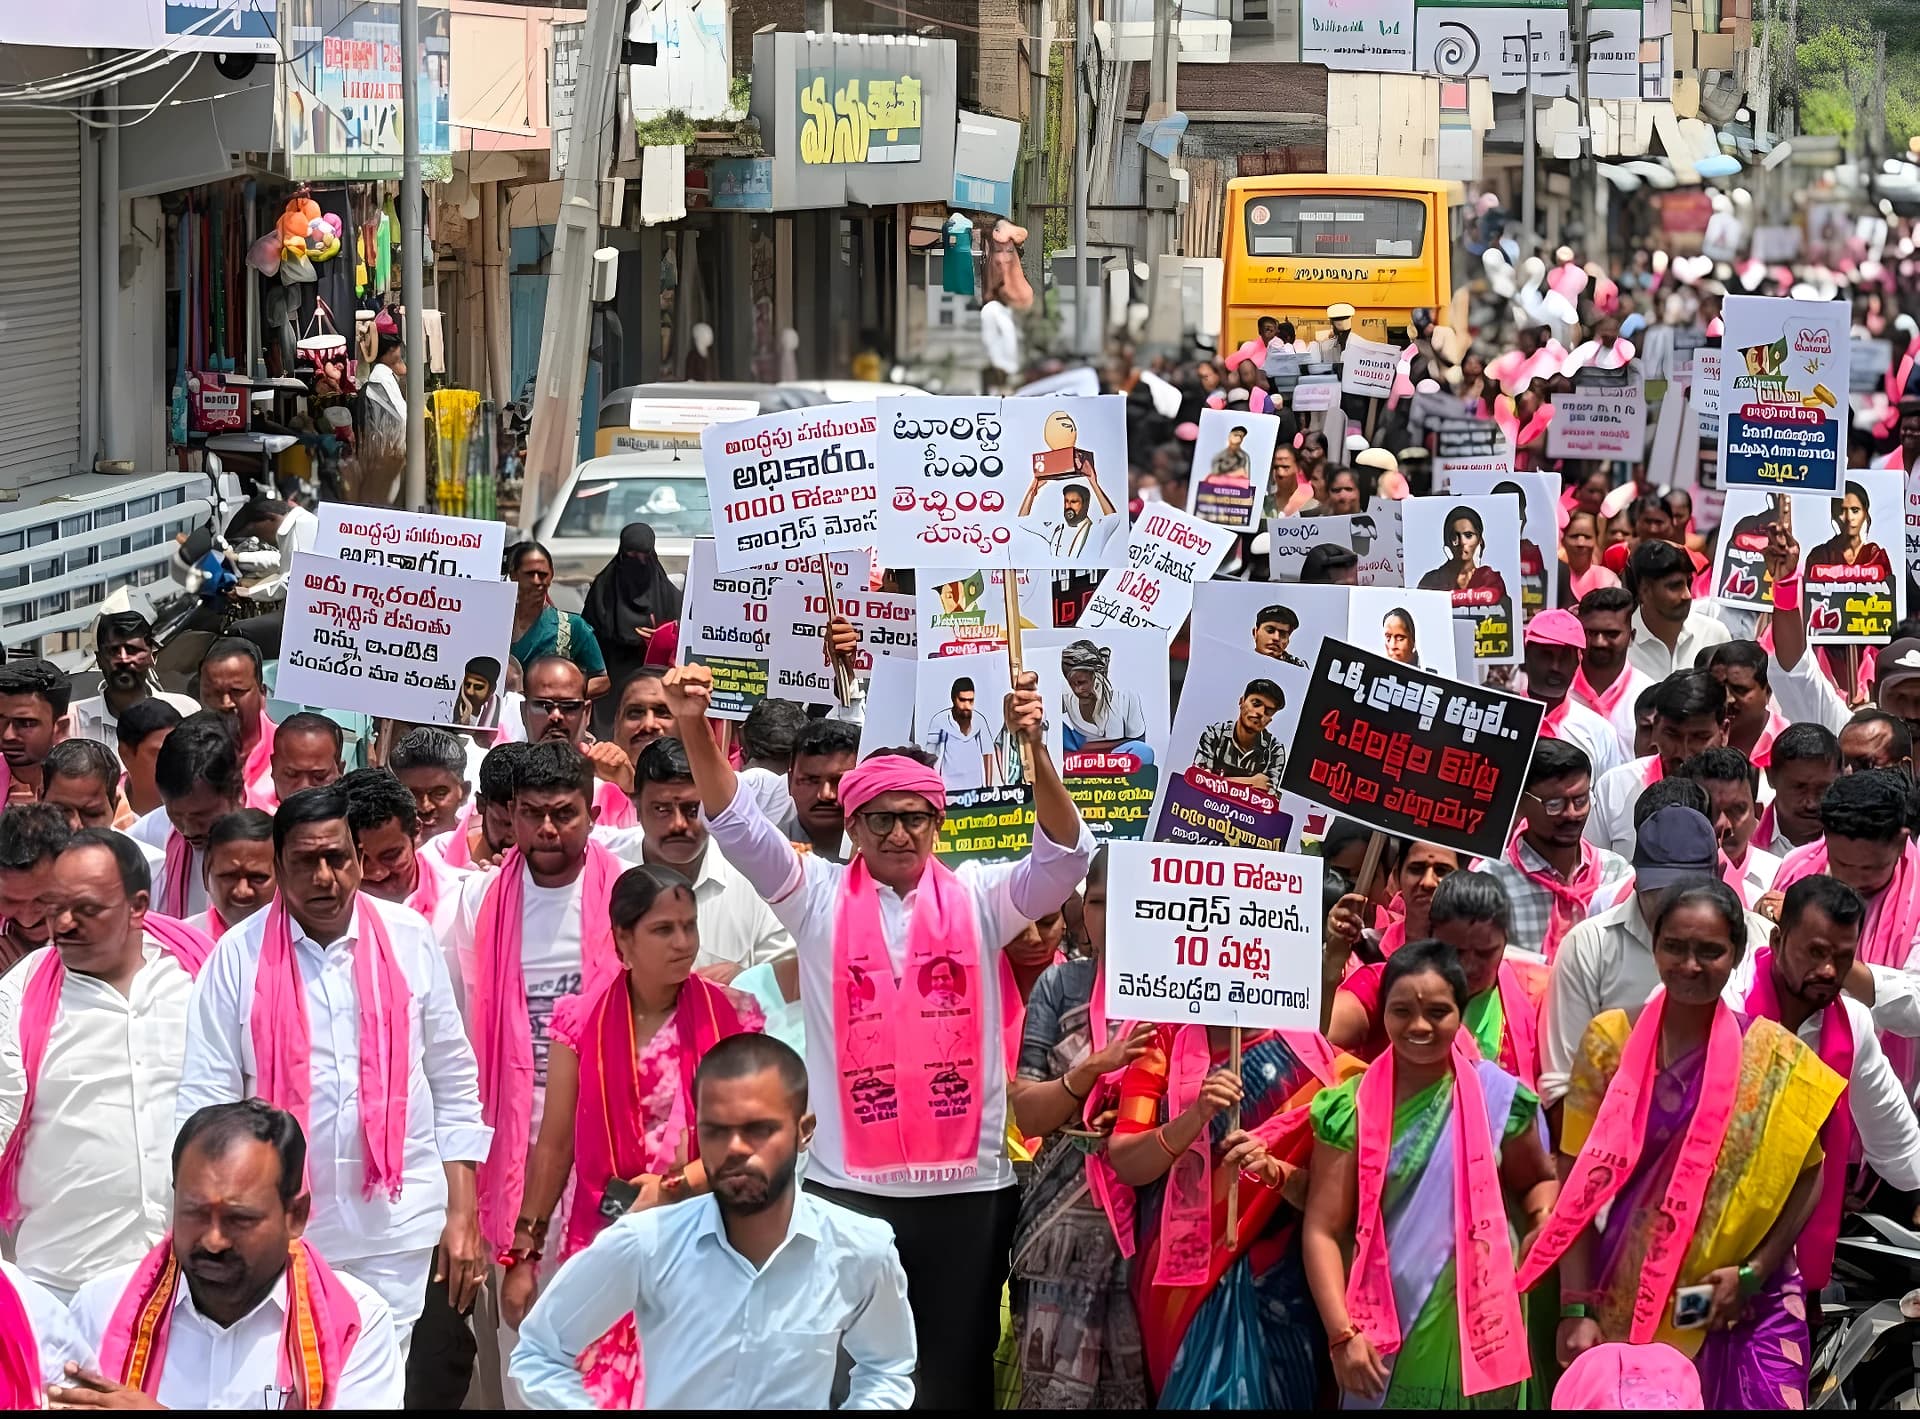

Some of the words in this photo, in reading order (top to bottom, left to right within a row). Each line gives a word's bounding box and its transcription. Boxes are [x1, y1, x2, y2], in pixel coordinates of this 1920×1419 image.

[893, 412, 1002, 451] టూరిస్ట్
[924, 443, 1004, 477] సీఎం
[724, 493, 785, 524] 1000
[892, 486, 1005, 521] తెచ్చింది
[916, 523, 1011, 554] శూన్యం
[352, 583, 462, 613] గ్యారంటీలు
[743, 602, 768, 623] 10
[368, 665, 399, 683] మా
[1150, 857, 1225, 887] 1000
[1233, 862, 1303, 894] రోజుల
[1134, 895, 1231, 932] కాంగ్రెస్
[1239, 900, 1310, 933] పాలన..
[1174, 935, 1209, 966] 10
[1218, 935, 1271, 980] ఏళ్లు
[1118, 972, 1221, 1014] వెనకబడ్డది
[1228, 980, 1310, 1010] తెలంగాణ!
